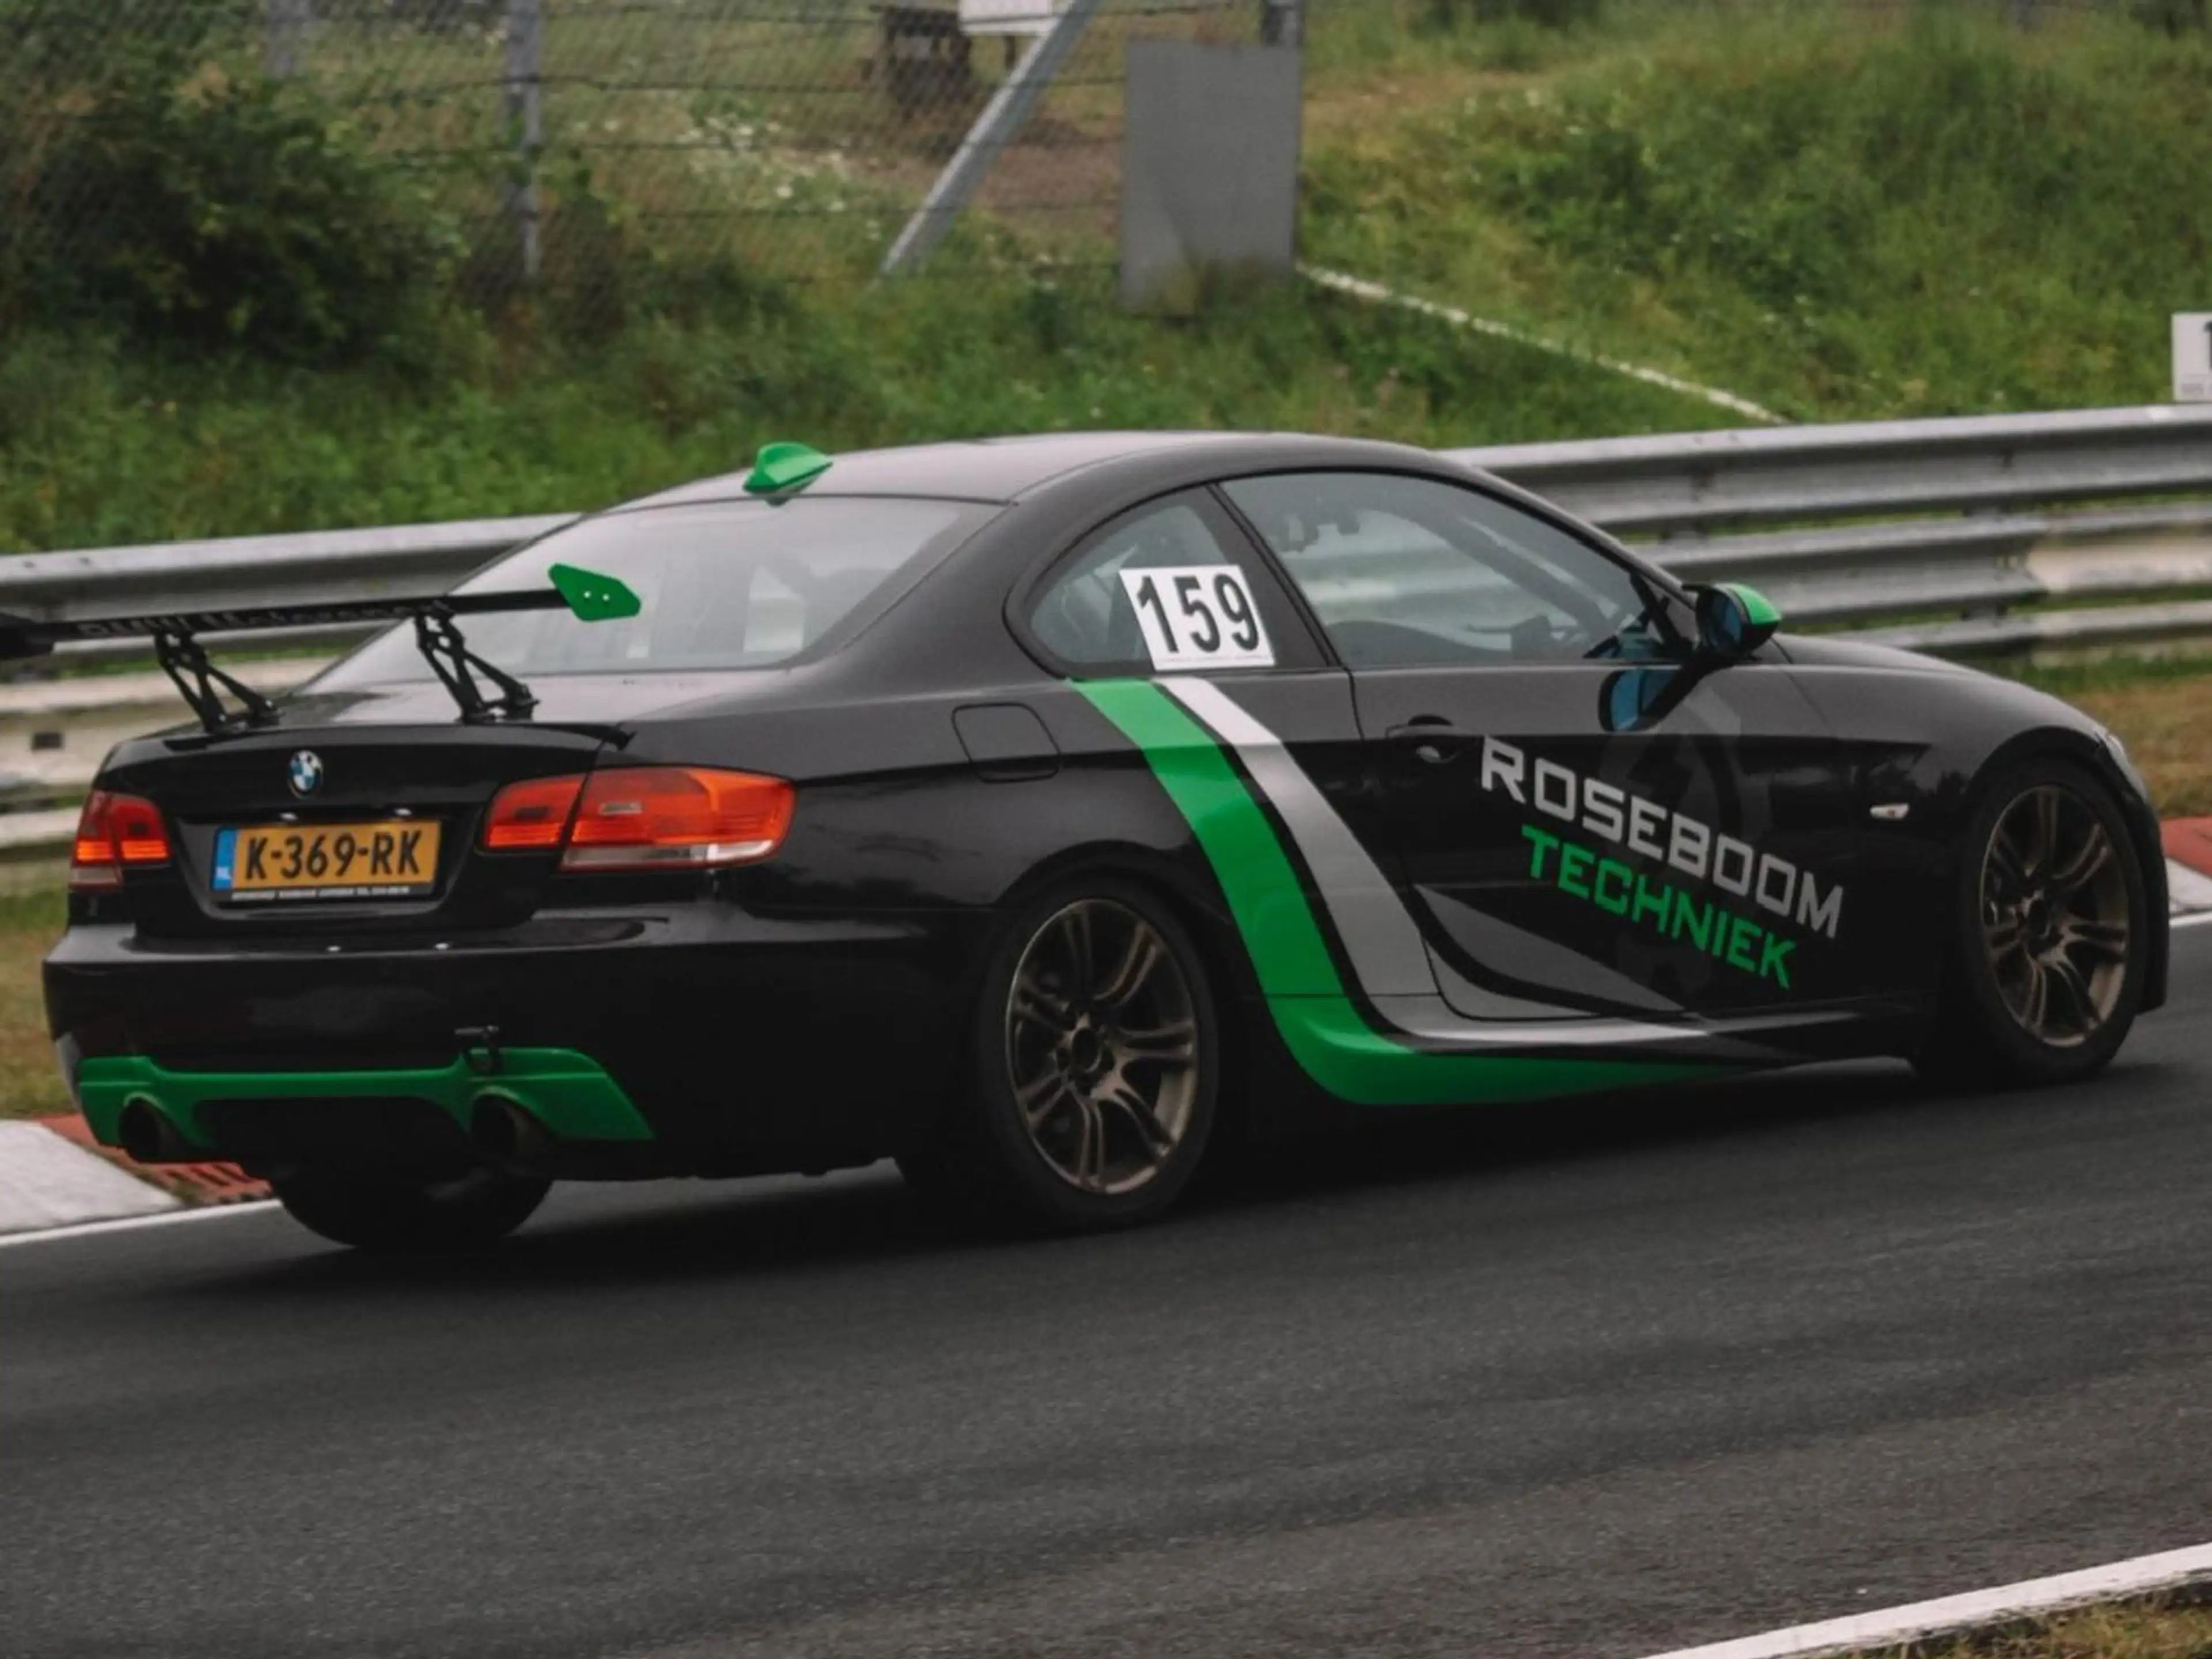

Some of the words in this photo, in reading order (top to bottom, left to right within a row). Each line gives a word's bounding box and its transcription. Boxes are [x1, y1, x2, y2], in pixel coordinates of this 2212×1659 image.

[1137, 573, 1260, 653] 159
[246, 831, 422, 880] K-369-RK
[1481, 734, 1843, 939] ROSEBOOM
[1521, 824, 1796, 990] TECHNIEK
